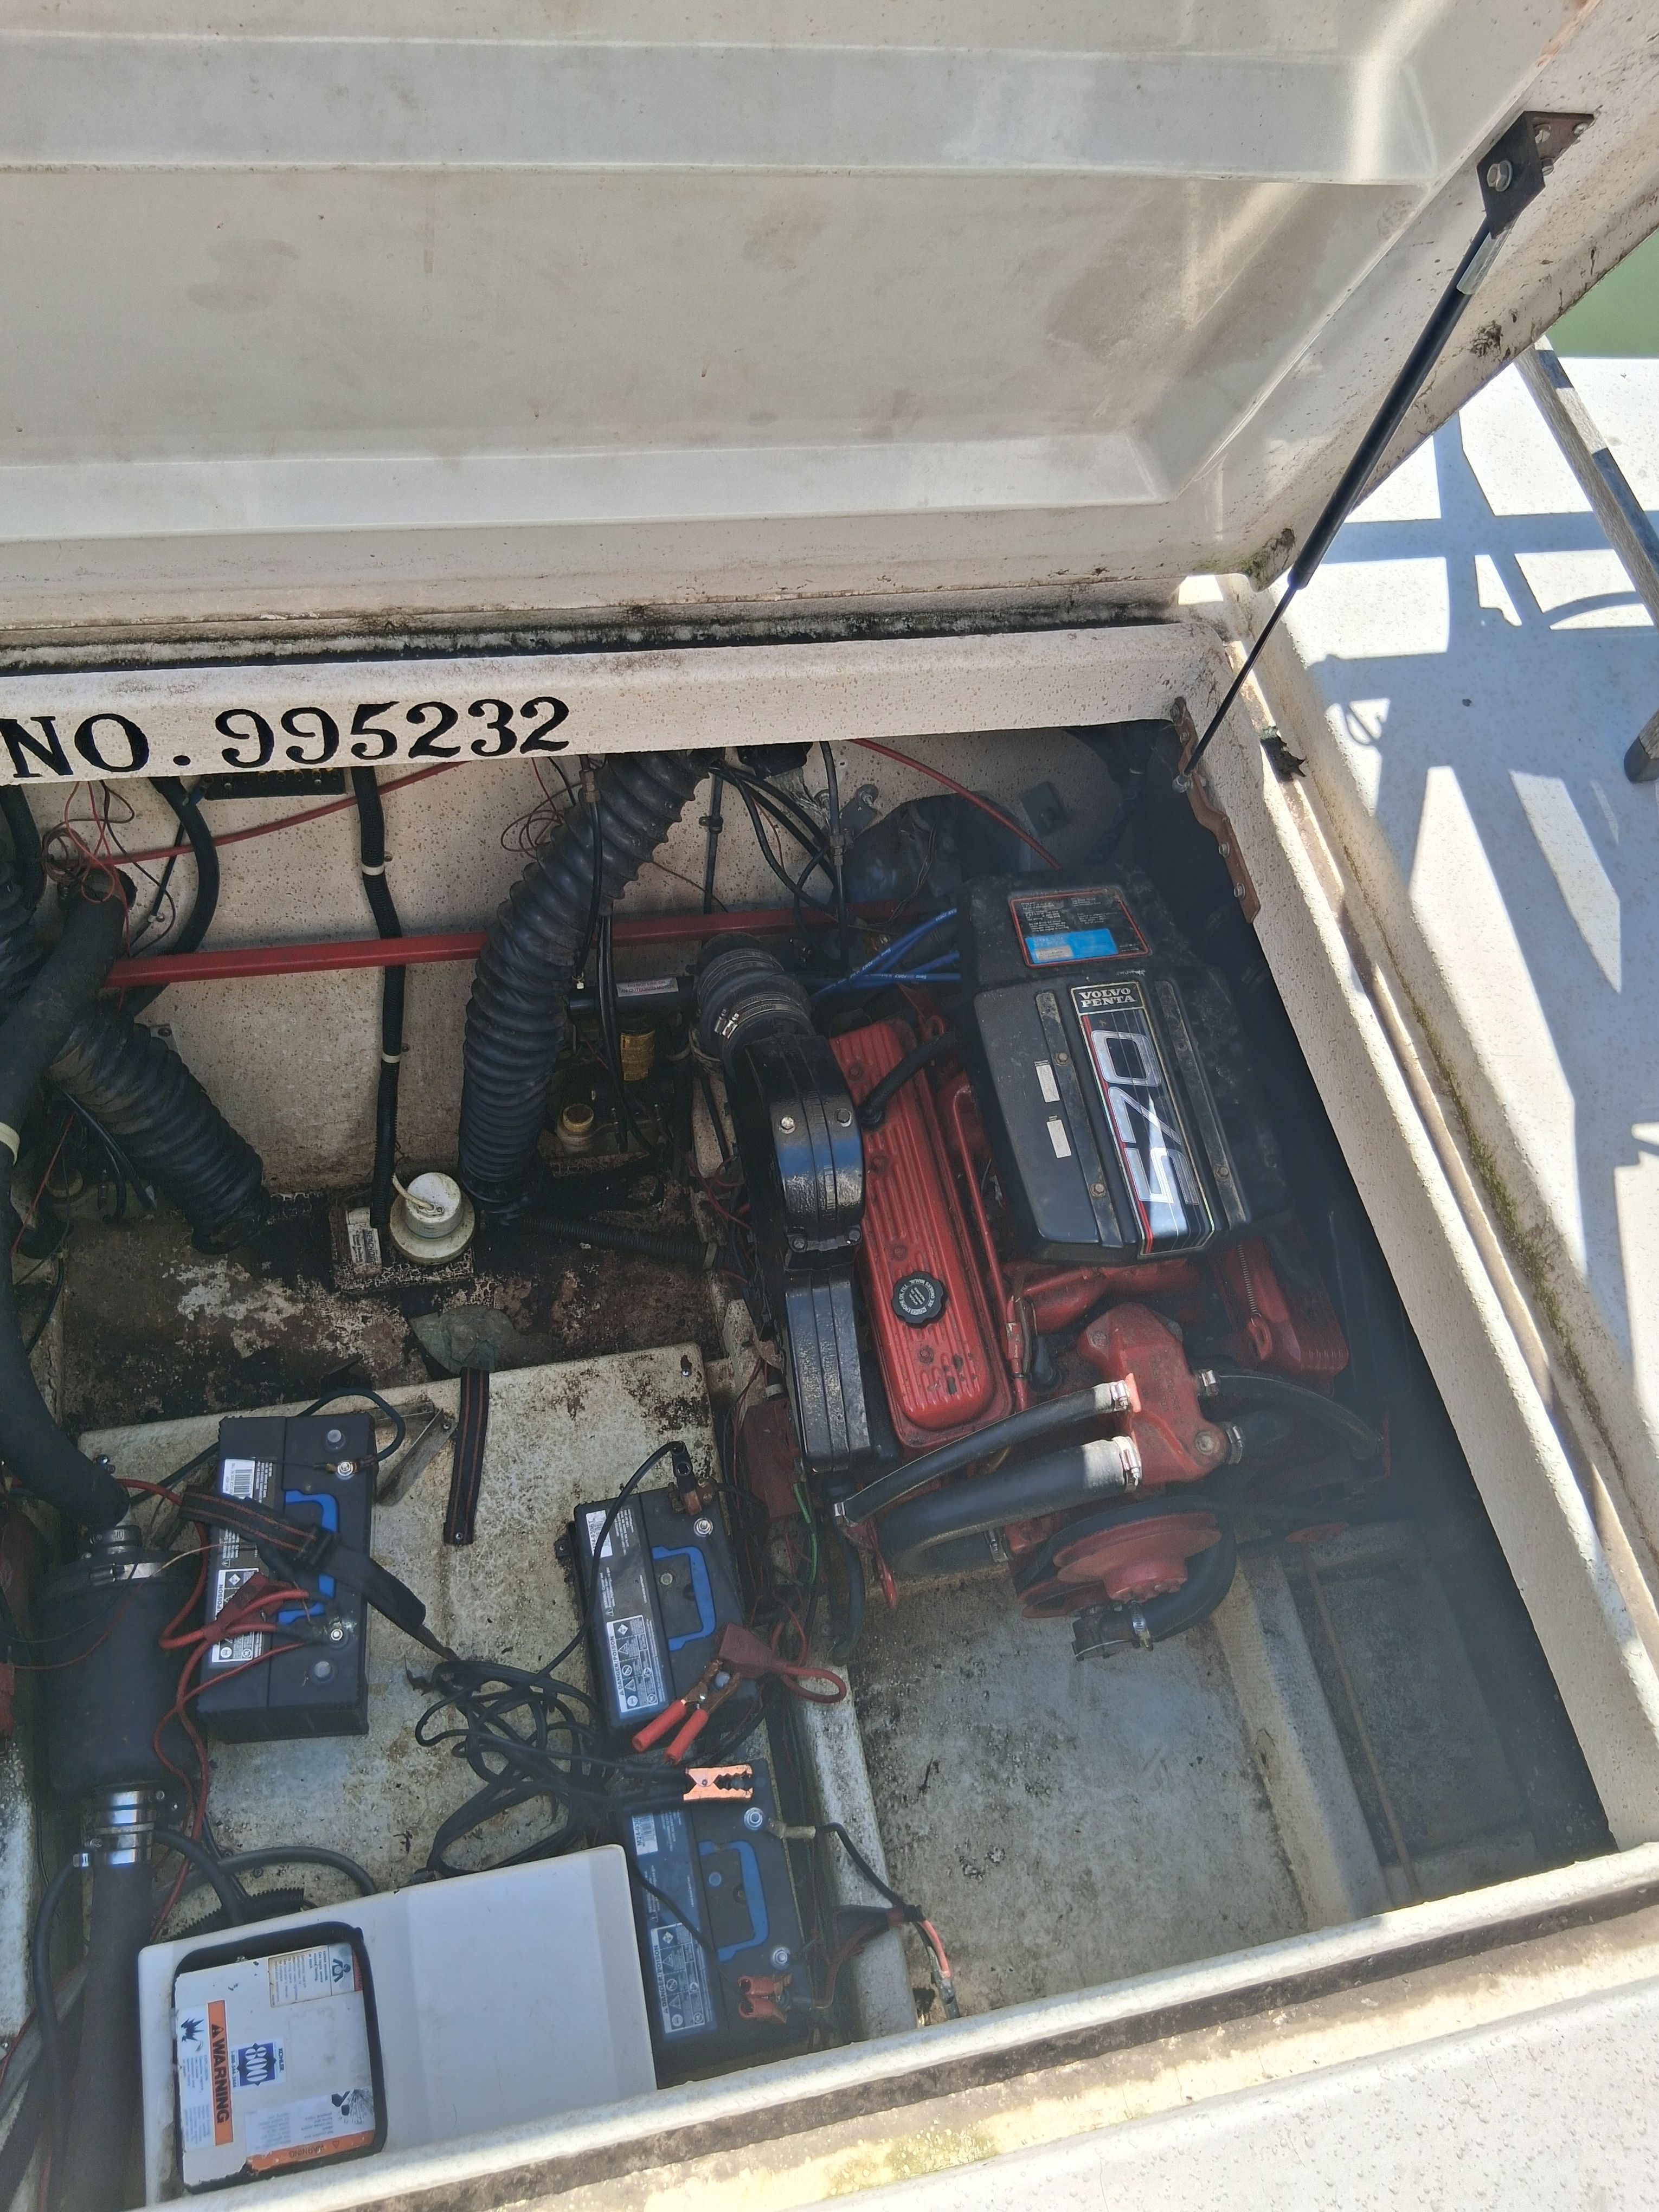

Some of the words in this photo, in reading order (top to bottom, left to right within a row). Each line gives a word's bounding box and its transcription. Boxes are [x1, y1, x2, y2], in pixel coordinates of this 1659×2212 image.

[0, 713, 191, 777] NO.
[214, 696, 569, 769] 995232
[1078, 987, 1131, 999] VOLVO
[1081, 994, 1136, 1007] PENTA
[1090, 1029, 1200, 1206] 570
[910, 1307, 927, 1315] NOTICE
[609, 1635, 623, 1689] DANGER/POISON
[653, 1944, 667, 2007] DANGER/POISON
[212, 2035, 230, 2123] WARNING
[243, 2046, 269, 2082] 800
[288, 2143, 324, 2158] WARNING
